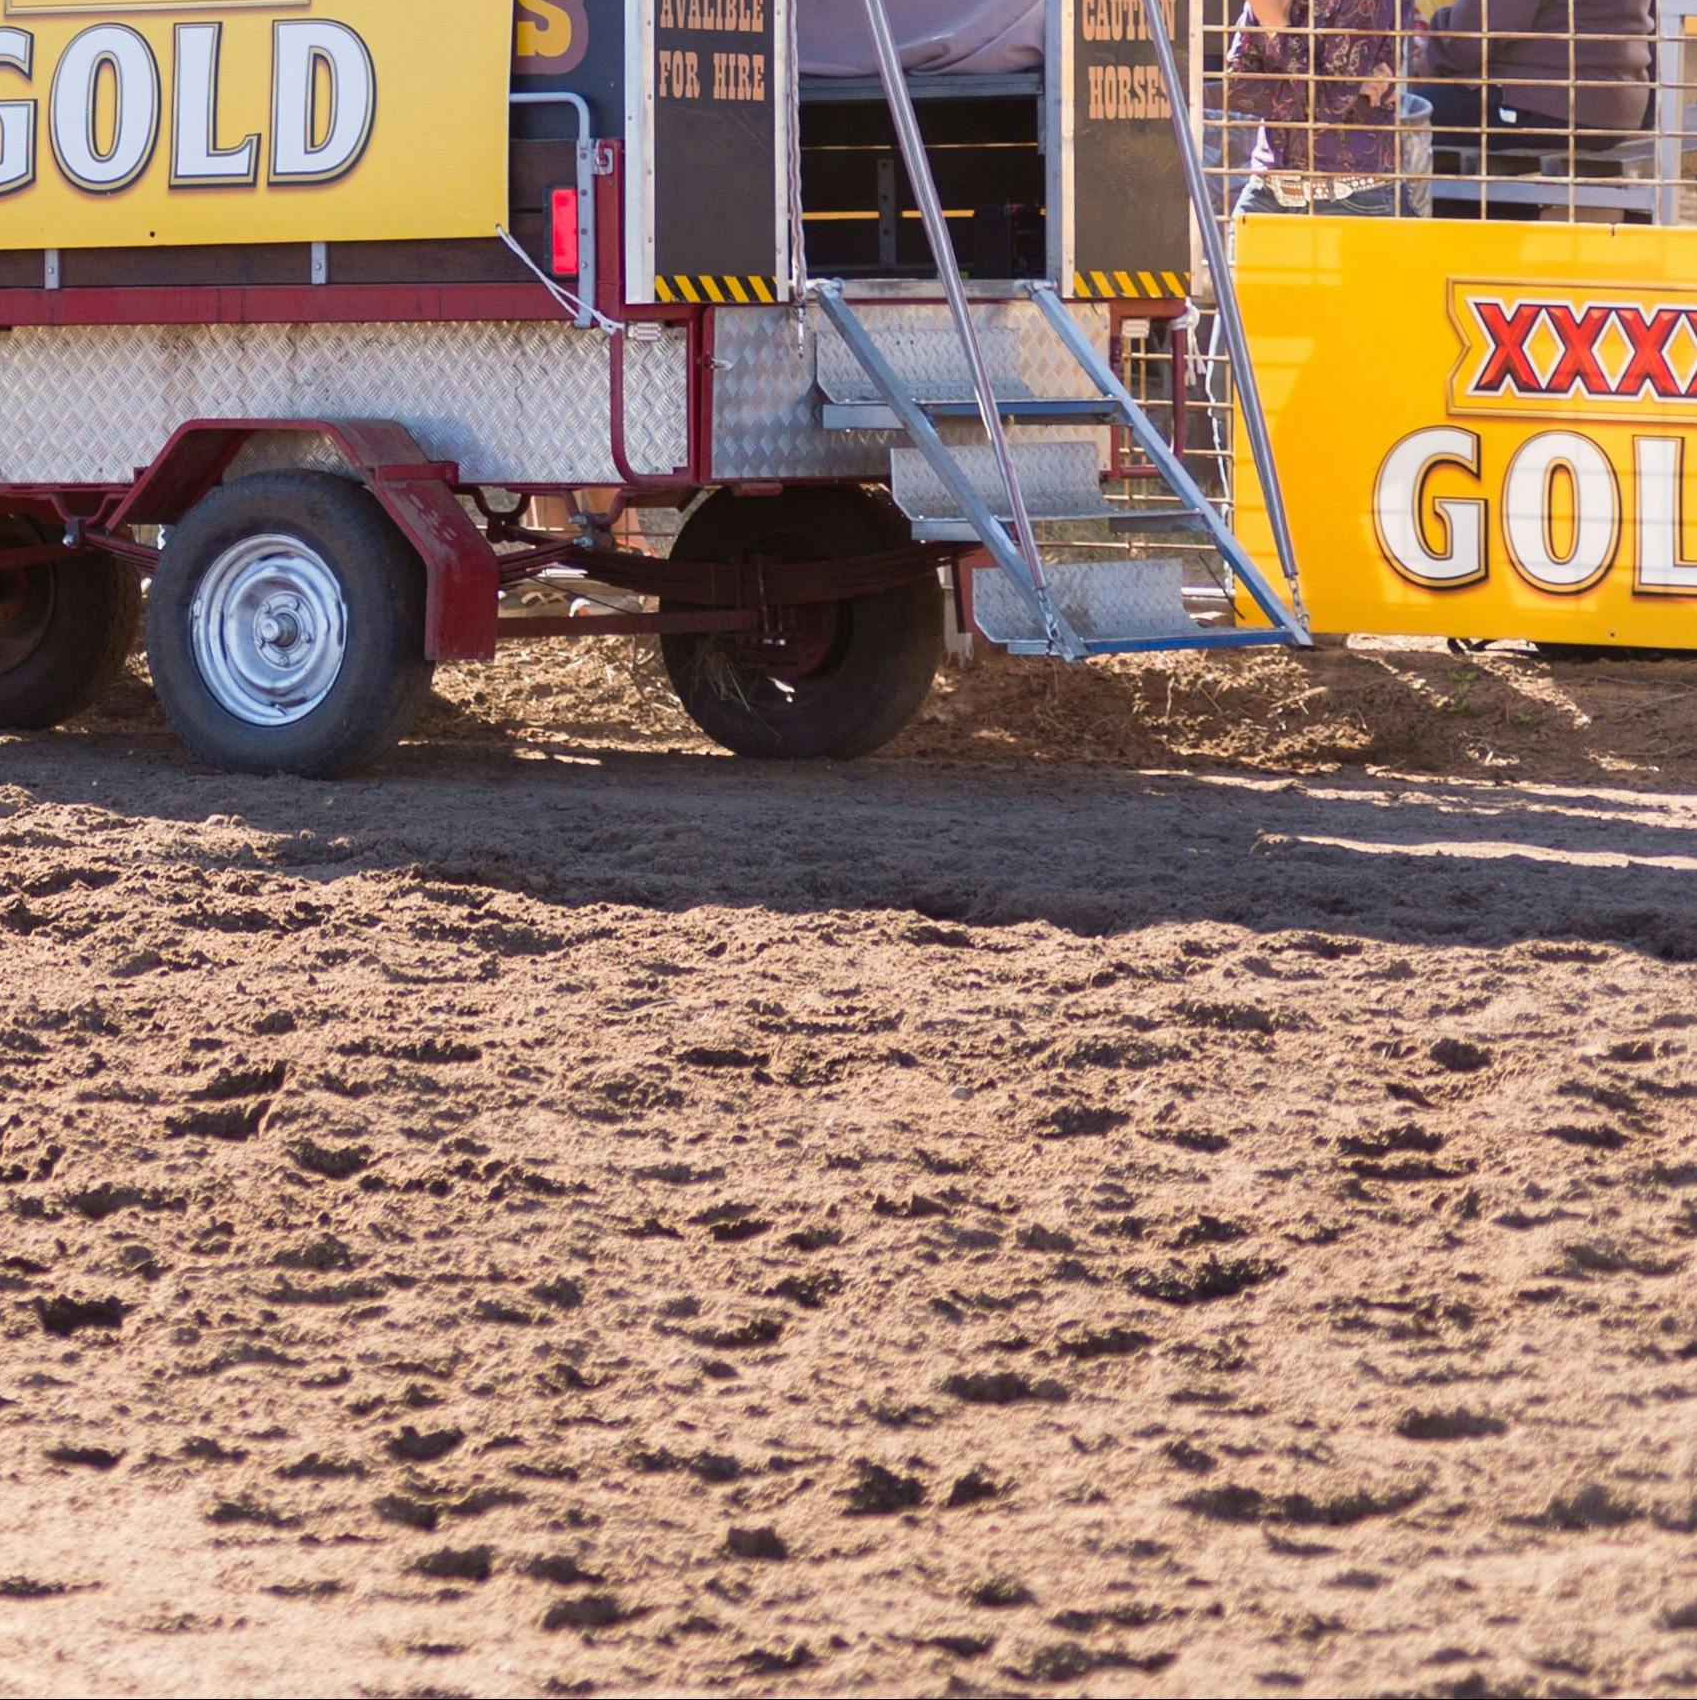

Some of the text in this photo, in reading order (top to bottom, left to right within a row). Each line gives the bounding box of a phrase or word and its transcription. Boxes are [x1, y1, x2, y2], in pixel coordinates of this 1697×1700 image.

[659, 50, 765, 101] FOR HIRE
[1466, 297, 1697, 402] XXX
